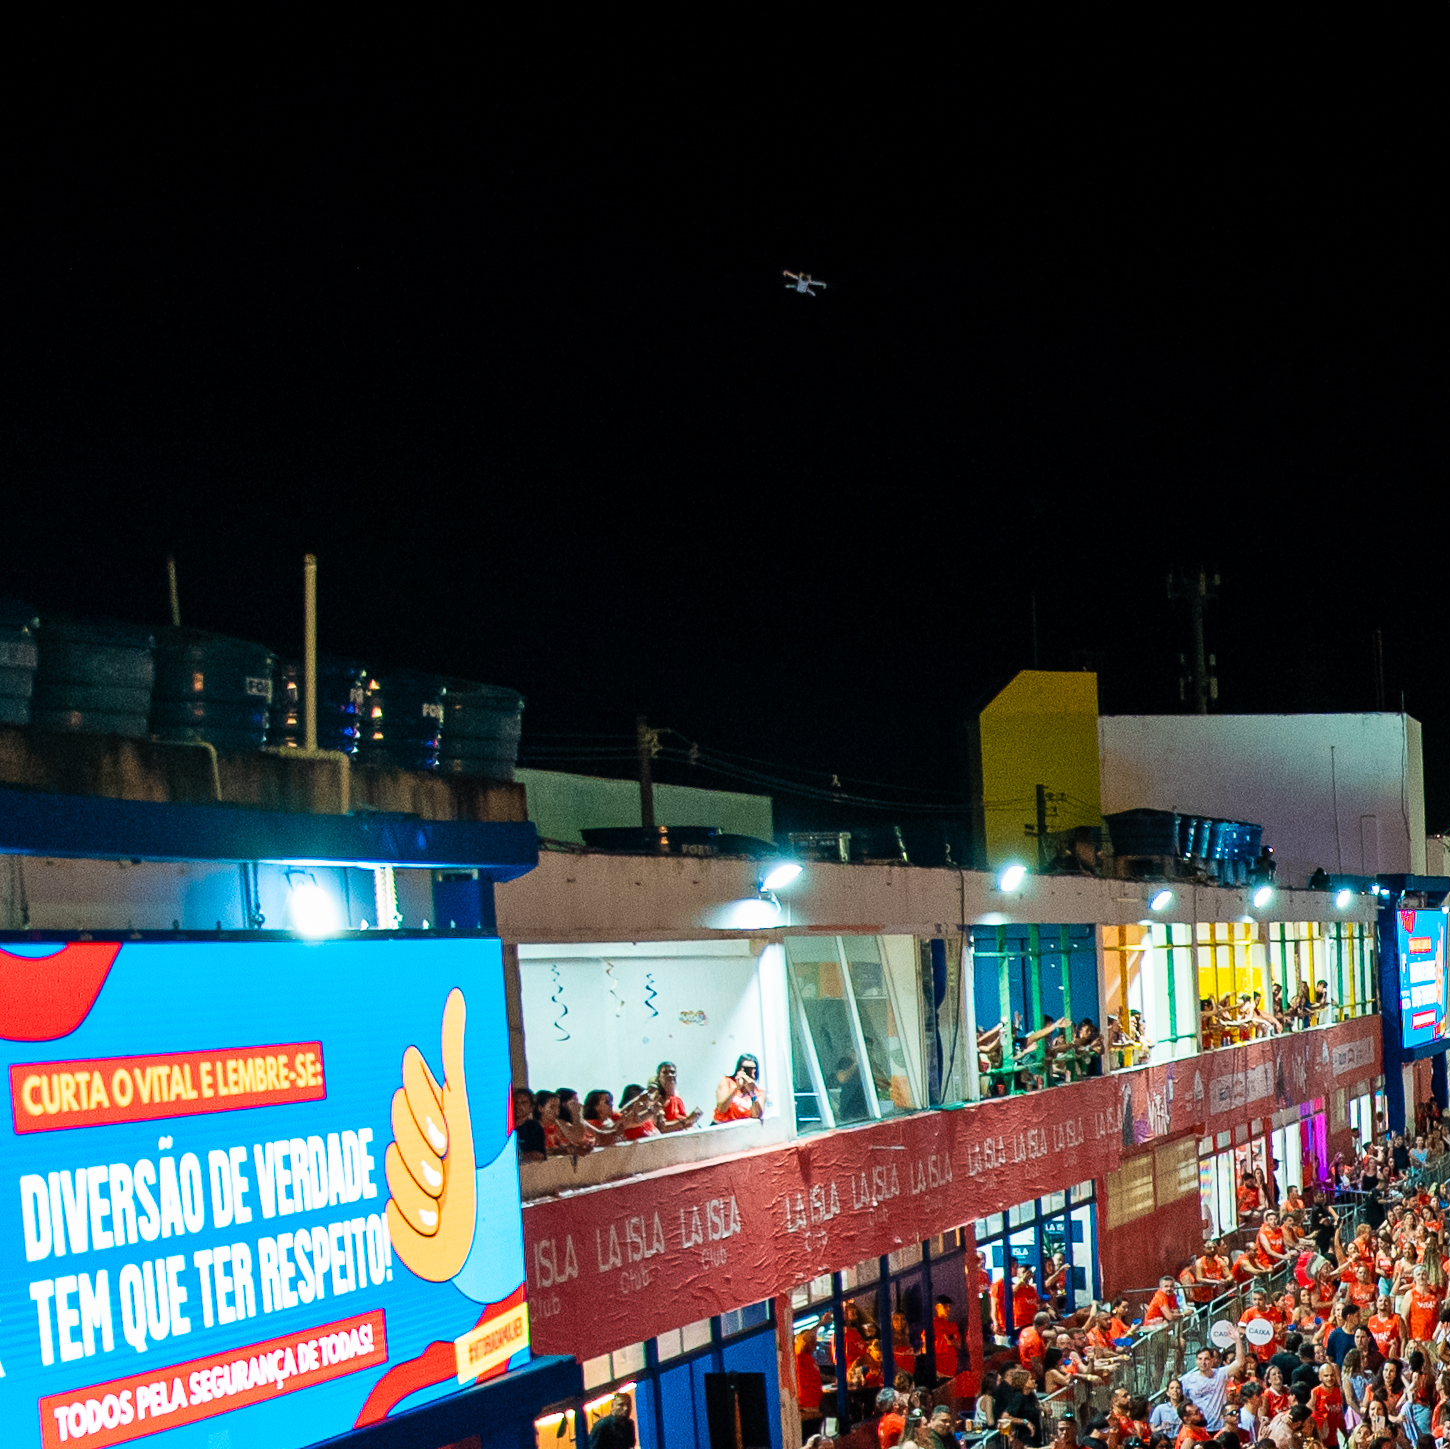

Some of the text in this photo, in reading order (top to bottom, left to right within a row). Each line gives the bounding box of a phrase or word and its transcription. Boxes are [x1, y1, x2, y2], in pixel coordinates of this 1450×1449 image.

[22, 1052, 323, 1116] CURTA O VITAL E LEMBRE-SE:
[20, 1127, 378, 1262] DIVERSÃO DE VERDADE
[680, 1195, 741, 1249] LA ISLA
[534, 1235, 578, 1289] ISLA
[597, 1211, 665, 1273] LA ISLA
[29, 1269, 115, 1367] TEM
[118, 1254, 191, 1353] QUE
[194, 1241, 256, 1328] TER
[258, 1212, 394, 1314] RESPEITO!
[1248, 1326, 1271, 1337] CAIXA
[54, 1323, 374, 1442] TODOS PELA SEGURANÇA DE TODAS!
